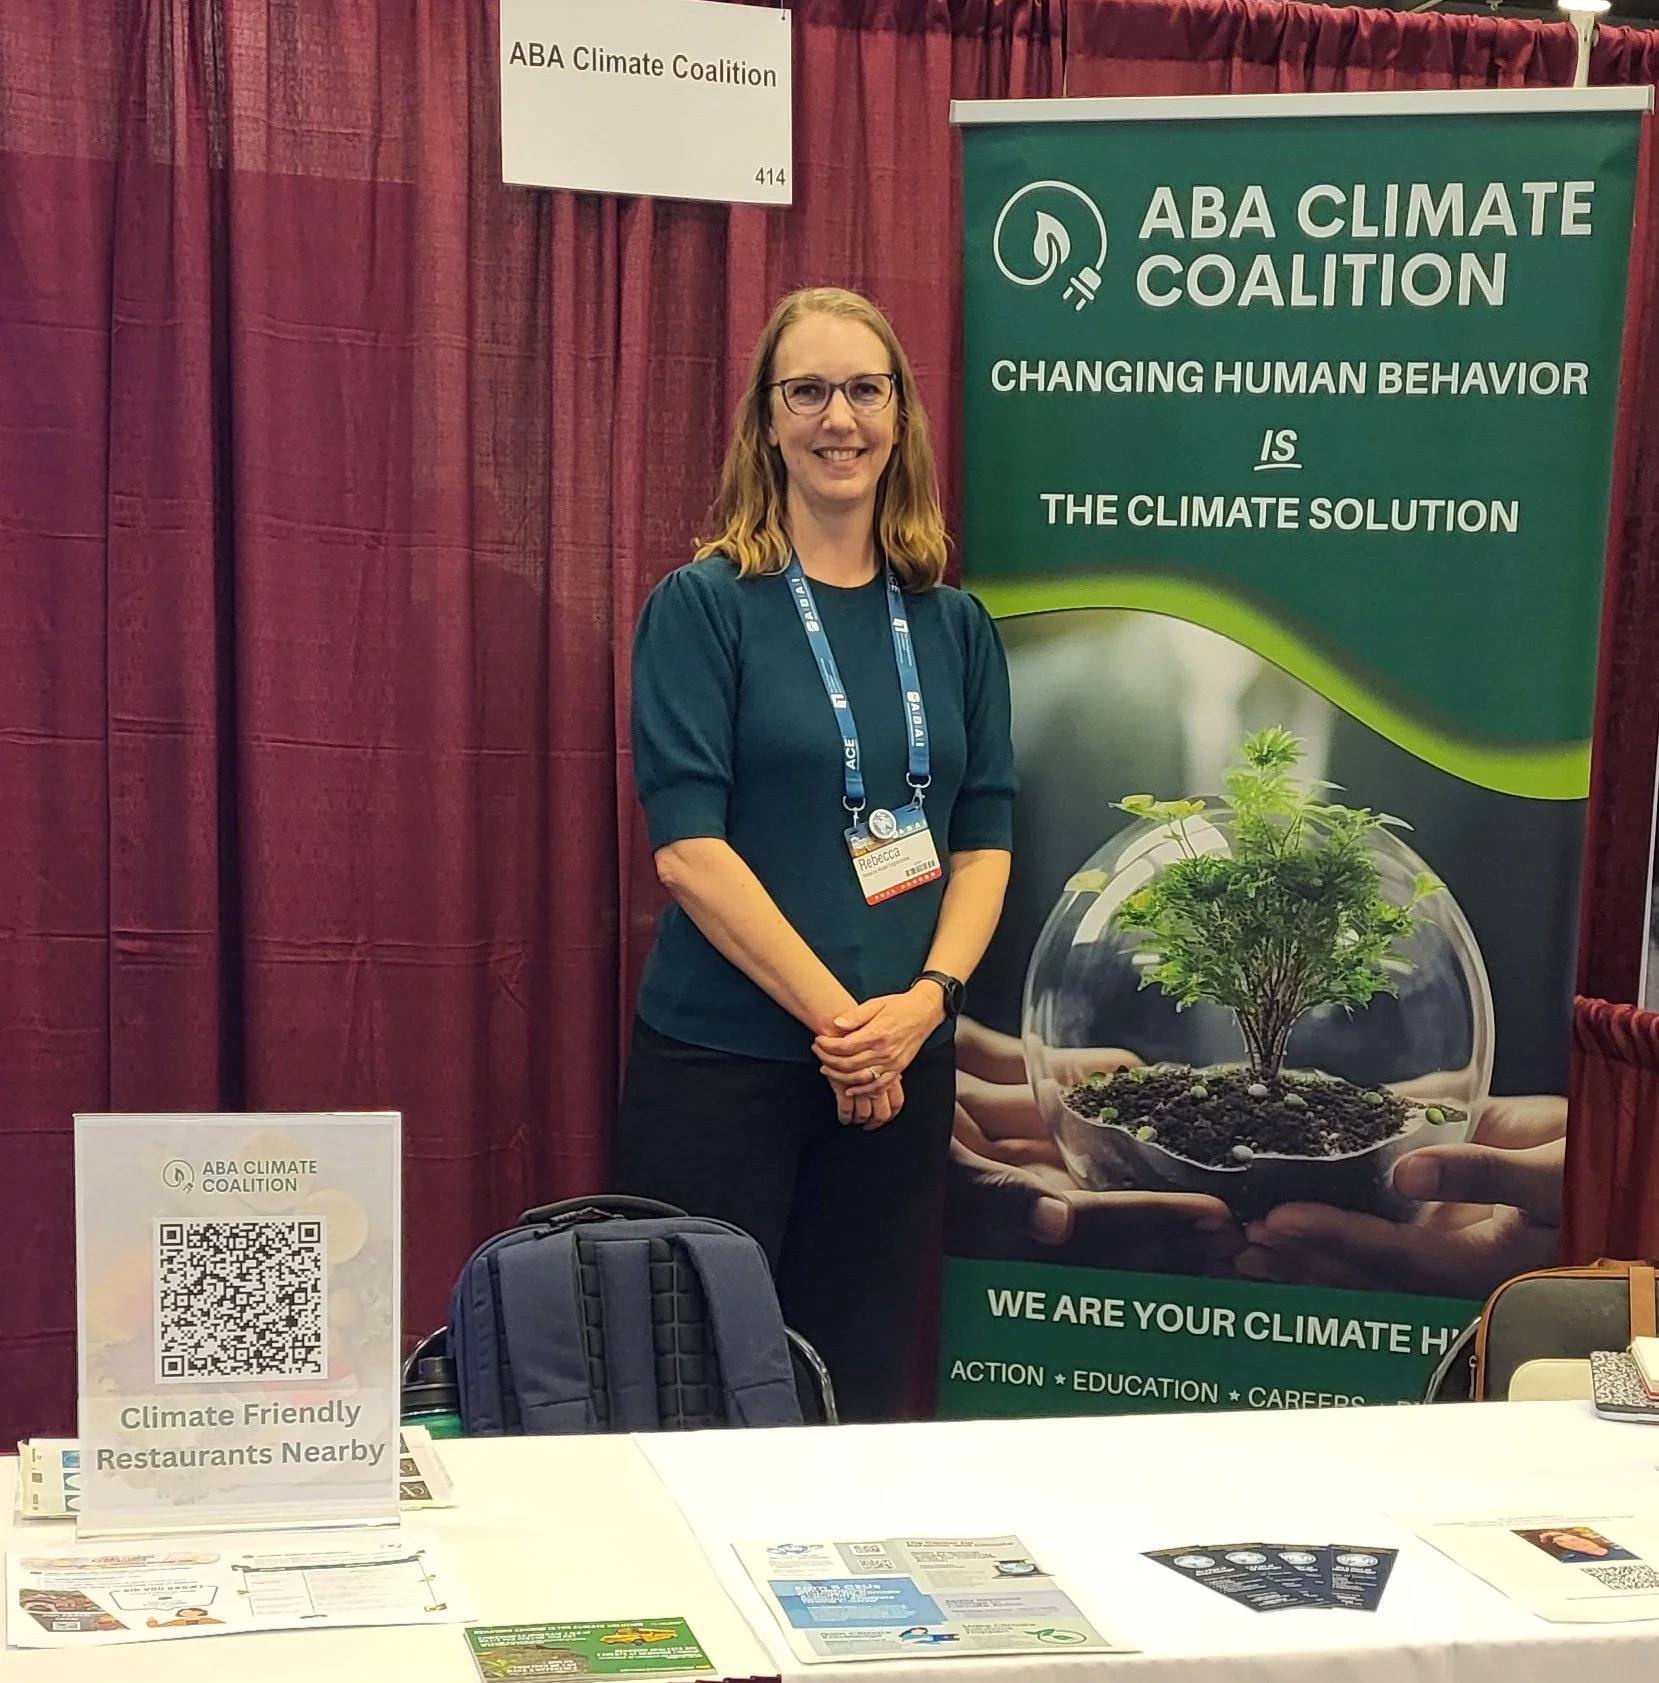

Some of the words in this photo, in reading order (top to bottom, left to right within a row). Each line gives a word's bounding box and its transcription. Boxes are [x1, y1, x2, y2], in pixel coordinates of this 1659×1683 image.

[508, 41, 565, 69] ABA
[573, 46, 664, 77] Climate
[672, 54, 777, 87] Coalition
[755, 167, 786, 186] 414
[1138, 185, 1276, 239] ABA
[1297, 181, 1596, 238] CLIMATE
[1135, 252, 1507, 307] COALITION
[990, 360, 1204, 393] CHANGING
[1213, 361, 1367, 395] HUMAN
[1377, 361, 1590, 396] BEHAVIOR
[1259, 429, 1299, 462] IS
[1039, 493, 1119, 526] THE
[1127, 495, 1300, 530] CLIMATE
[1308, 497, 1520, 533] SOLUTION
[844, 738, 857, 770] ACE
[858, 846, 901, 871] Rebecca
[202, 1160, 239, 1176] ABA
[243, 1159, 318, 1175] CLIMATE
[202, 1177, 298, 1193] COALITION
[987, 1289, 1046, 1320] WE
[1053, 1295, 1125, 1327] ARE
[1132, 1301, 1236, 1338] YOUR
[1244, 1311, 1412, 1353] CLIMATE
[950, 1360, 1044, 1387] ACTION
[1073, 1370, 1218, 1404] EDUCATION
[120, 1406, 235, 1429] Climate
[243, 1400, 361, 1428] Friendly
[97, 1443, 272, 1471] Restaurants
[281, 1438, 385, 1467] Nearby
